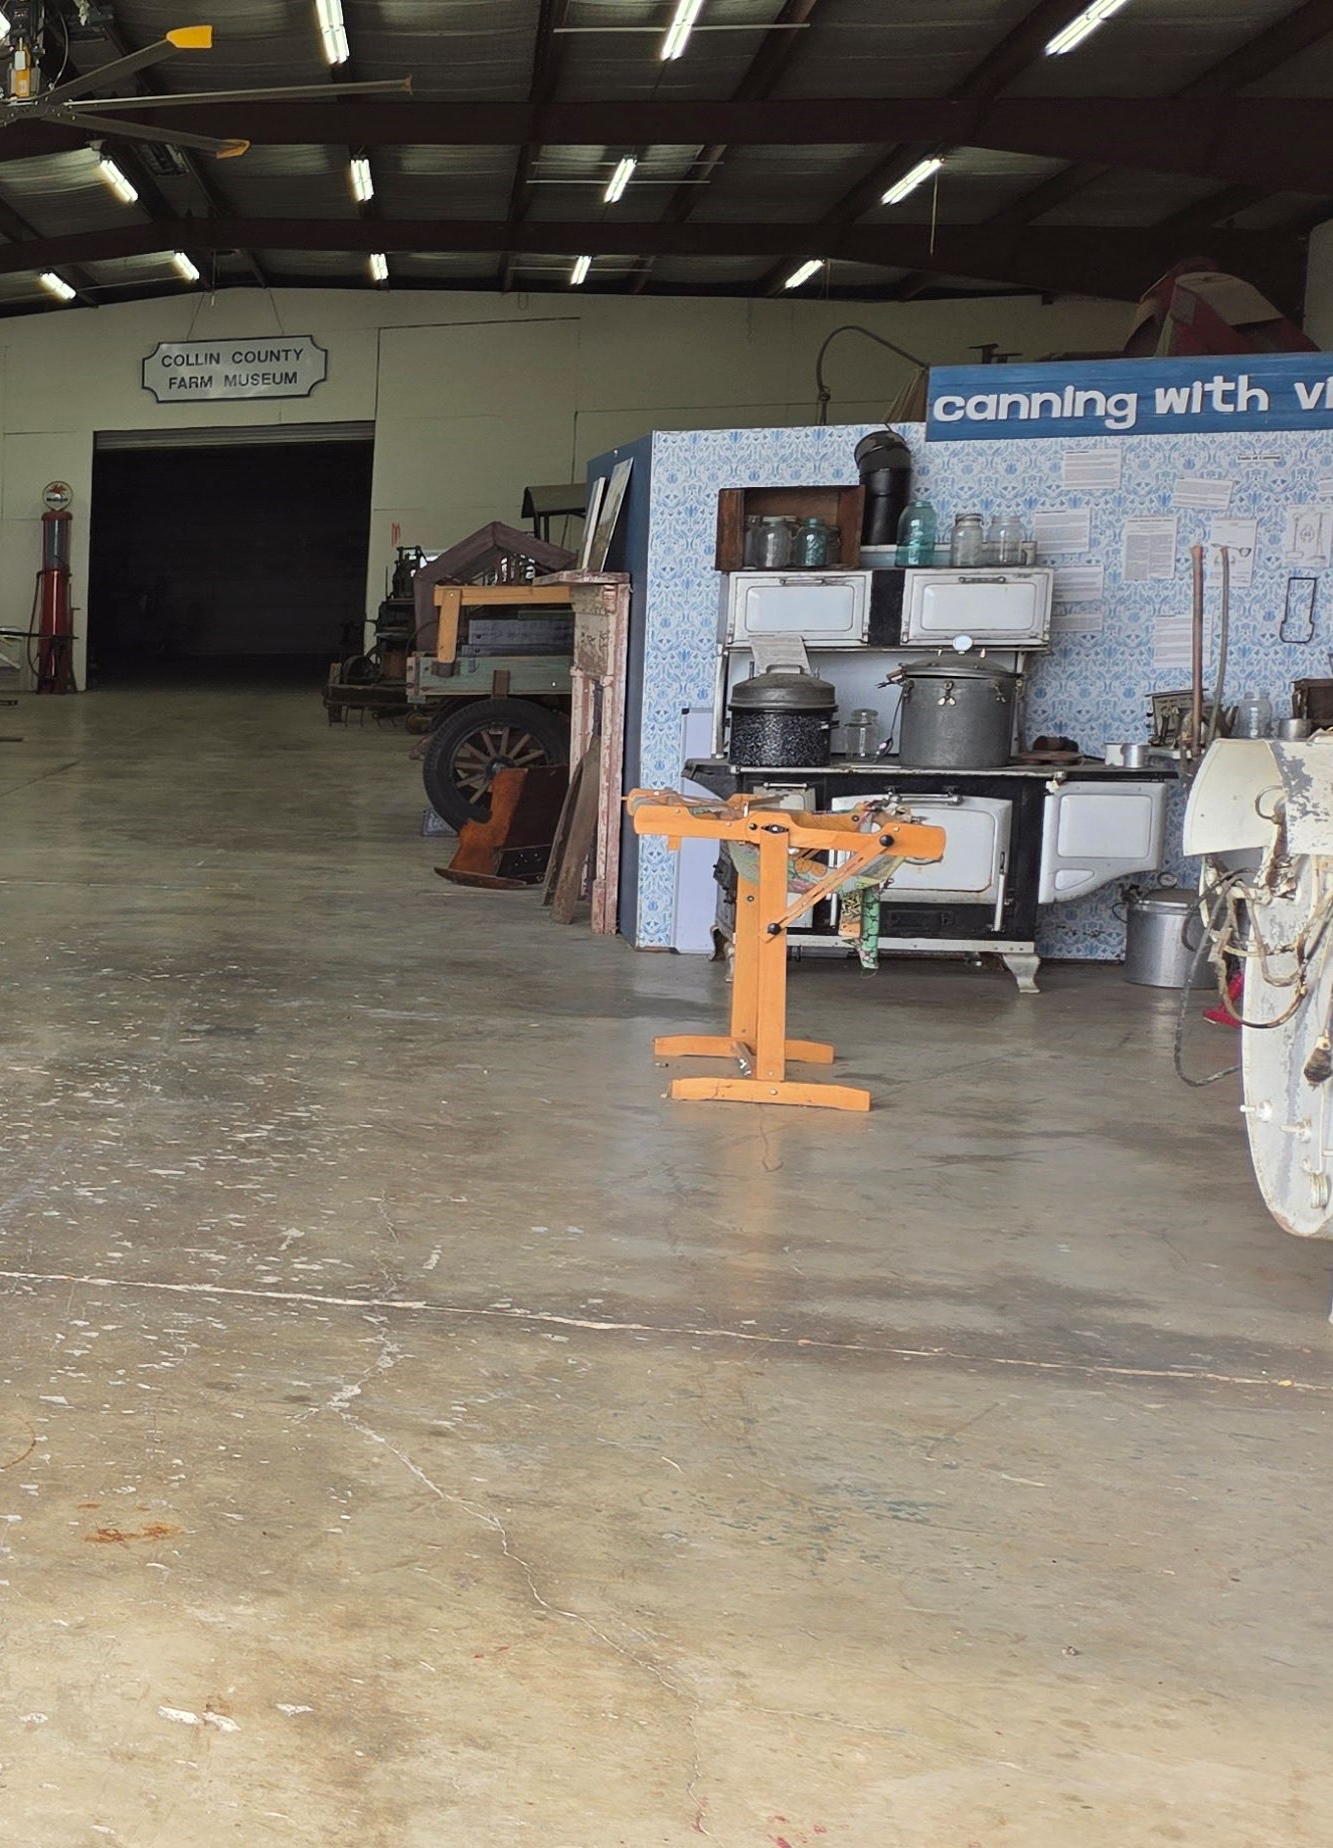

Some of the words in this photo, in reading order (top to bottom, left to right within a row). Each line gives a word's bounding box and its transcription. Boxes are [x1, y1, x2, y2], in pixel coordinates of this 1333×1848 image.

[161, 351, 221, 368] COLLIN
[231, 348, 304, 364] COUNTY
[168, 375, 213, 390] FARM
[223, 371, 298, 387] MUSEUM
[932, 384, 1138, 431] canning
[1154, 374, 1270, 415] with
